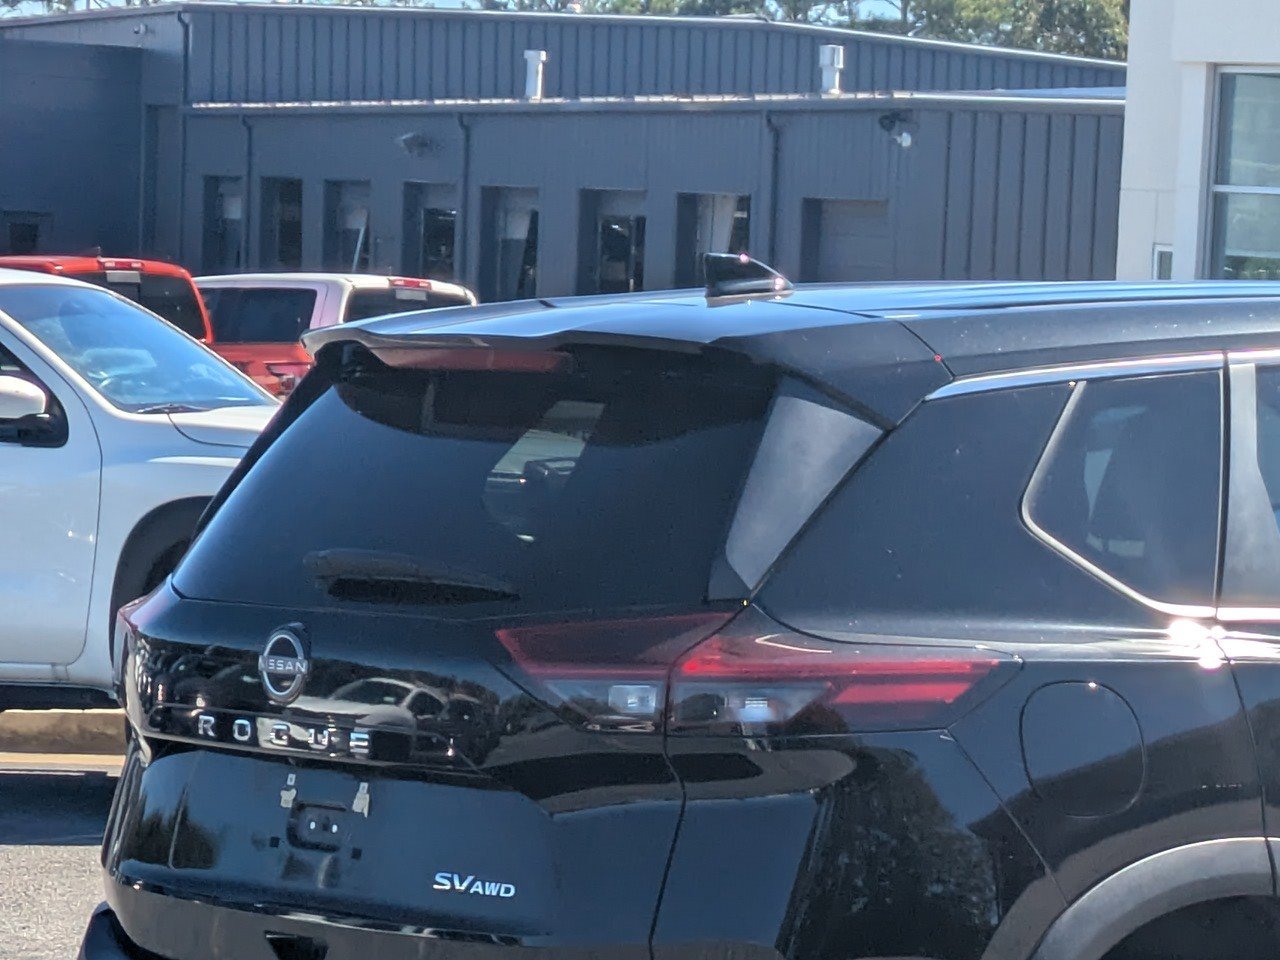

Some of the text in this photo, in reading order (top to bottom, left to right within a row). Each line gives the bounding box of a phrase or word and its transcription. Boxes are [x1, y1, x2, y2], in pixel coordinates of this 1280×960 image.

[198, 714, 370, 754] ROGUE
[433, 872, 516, 897] SV AWD
